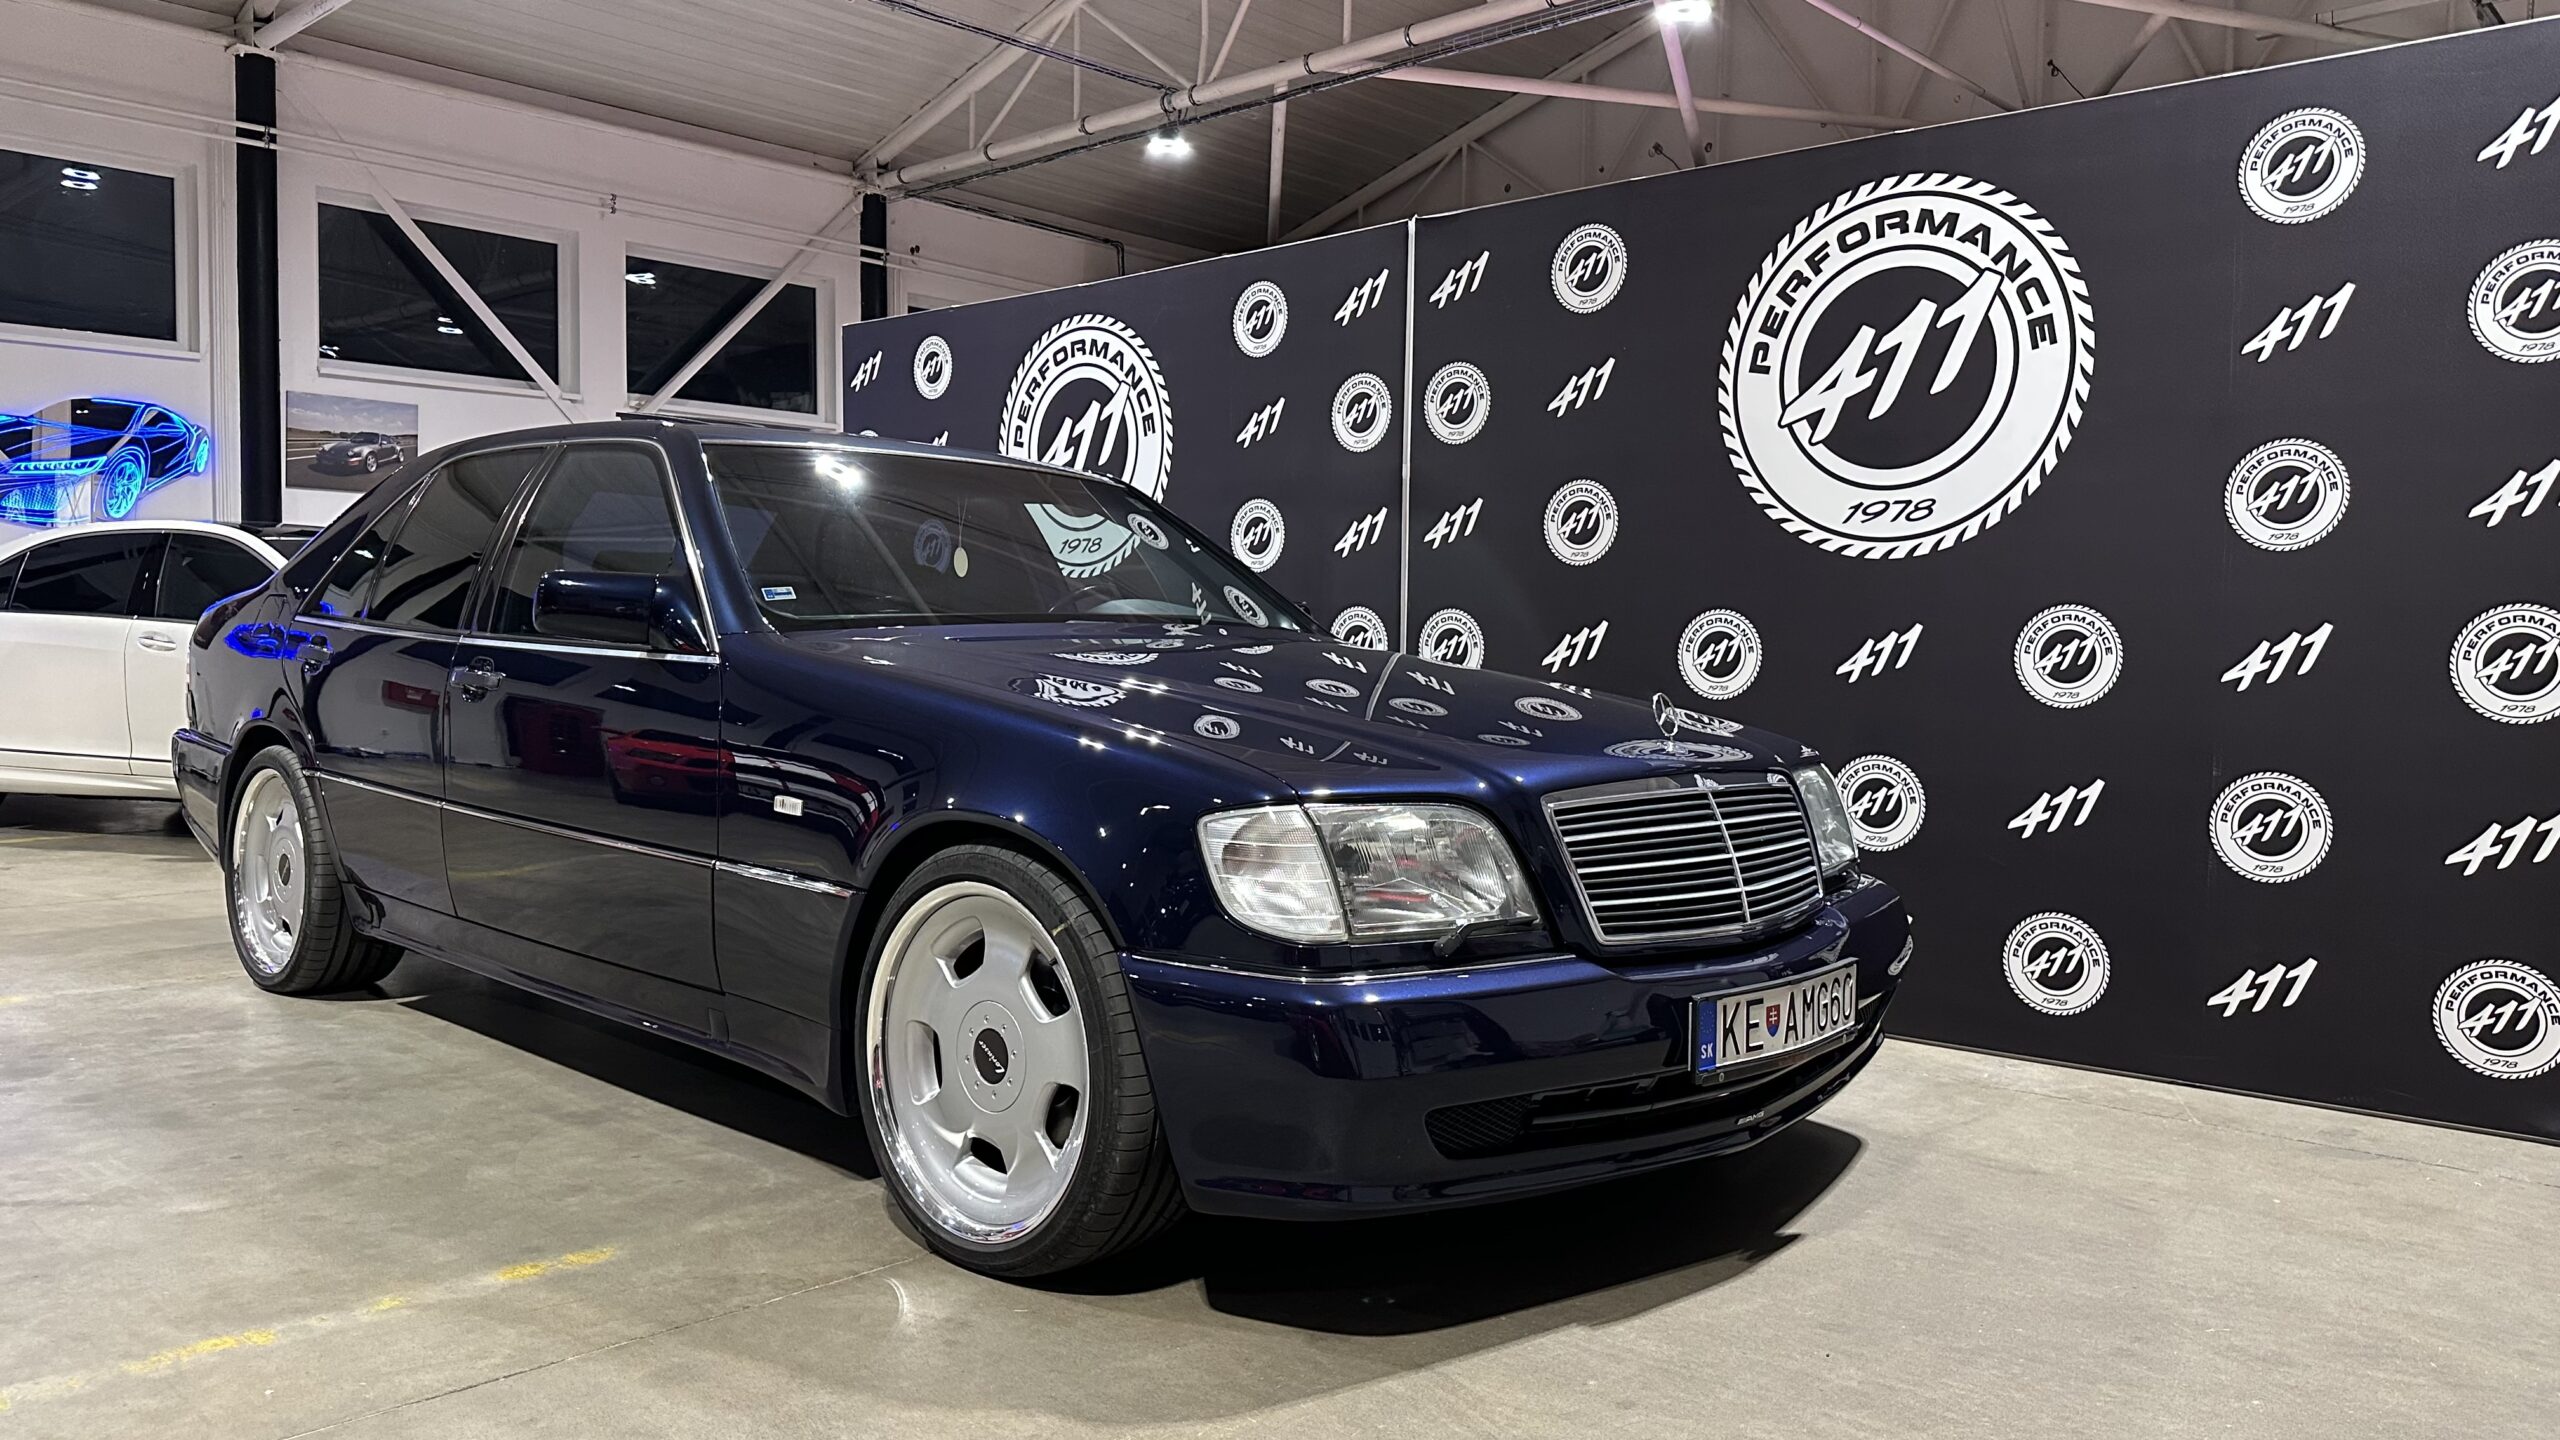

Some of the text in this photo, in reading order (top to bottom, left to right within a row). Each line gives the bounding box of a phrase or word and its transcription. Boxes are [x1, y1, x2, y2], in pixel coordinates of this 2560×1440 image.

[2249, 117, 2354, 172] PERFORMANCE
[2476, 95, 2560, 169] 41
[2260, 133, 2338, 192] 411
[2282, 202, 2316, 214] 1978
[1558, 231, 1621, 272] PERFORMANCE
[1565, 245, 1610, 288] 411
[1334, 269, 1389, 326] 411
[1429, 251, 1490, 309] 411
[1748, 208, 2058, 376] PERFORMANCE
[2481, 251, 2560, 304] PERFORM
[1238, 288, 1283, 322] PERFORMANCE
[1243, 300, 1275, 335] 411
[2241, 282, 2356, 363] 411
[2493, 279, 2560, 326] 41
[1778, 267, 2004, 446] 411
[2519, 342, 2556, 352] 1978
[850, 350, 882, 392] 411
[1430, 369, 1484, 404] PERFORMANCE
[1547, 357, 1616, 418] 411
[1014, 339, 1155, 448] PERFORMANCE
[1337, 380, 1386, 414] PERFORMANCE
[1343, 391, 1378, 430] 411
[1436, 382, 1476, 419] 411
[1041, 380, 1131, 472] 411
[1236, 397, 1286, 449] 411
[2236, 449, 2339, 495] PERFORMANCE
[2246, 467, 2323, 517] 411
[1550, 486, 1612, 524] PERFORMANCE
[1841, 498, 1937, 525] 1978
[2468, 459, 2560, 528] 41
[1236, 505, 1280, 536] PERFORMANCE
[1241, 517, 1272, 550] 411
[1334, 506, 1388, 558] 411
[1423, 497, 1483, 549] 411
[1557, 501, 1602, 540] 411
[2267, 532, 2300, 542] 1978
[1059, 537, 1102, 554] 1978
[1335, 613, 1382, 644] ERFORMANCE
[1425, 615, 1479, 649] PERFORMANCE
[1431, 630, 1469, 662] 411
[1541, 620, 1609, 673] 411
[1685, 617, 1754, 654] PERFORMANCE
[2024, 614, 2114, 656] PERFORMANCE
[2463, 614, 2560, 661] PERFORMA
[1692, 633, 1743, 672] 411
[1835, 622, 1924, 683] 411
[2033, 632, 2100, 676] 411
[2220, 622, 2334, 692] 411
[2475, 636, 2560, 685] 411
[2052, 691, 2080, 699] 1978
[2500, 704, 2537, 714] 1978
[1840, 763, 1917, 805] ERFORMANCE
[1847, 781, 1904, 820] 411
[2007, 777, 2106, 839] 411
[2220, 782, 2321, 830] PERFORMANCE
[2231, 803, 2306, 846] 411
[1863, 834, 1889, 843] 1978
[2252, 863, 2284, 873] 1978
[2012, 921, 2101, 968] PERFORMANCE
[2022, 942, 2087, 981] 411
[2040, 997, 2069, 1007] 1978
[2206, 957, 2318, 1018] 411
[2446, 970, 2560, 1028] PERFORMANCE
[1721, 973, 1853, 1058] KE AMG60
[2457, 996, 2543, 1037] 411
[1701, 1043, 1714, 1060] SK
[2482, 1058, 2518, 1069] 1978
